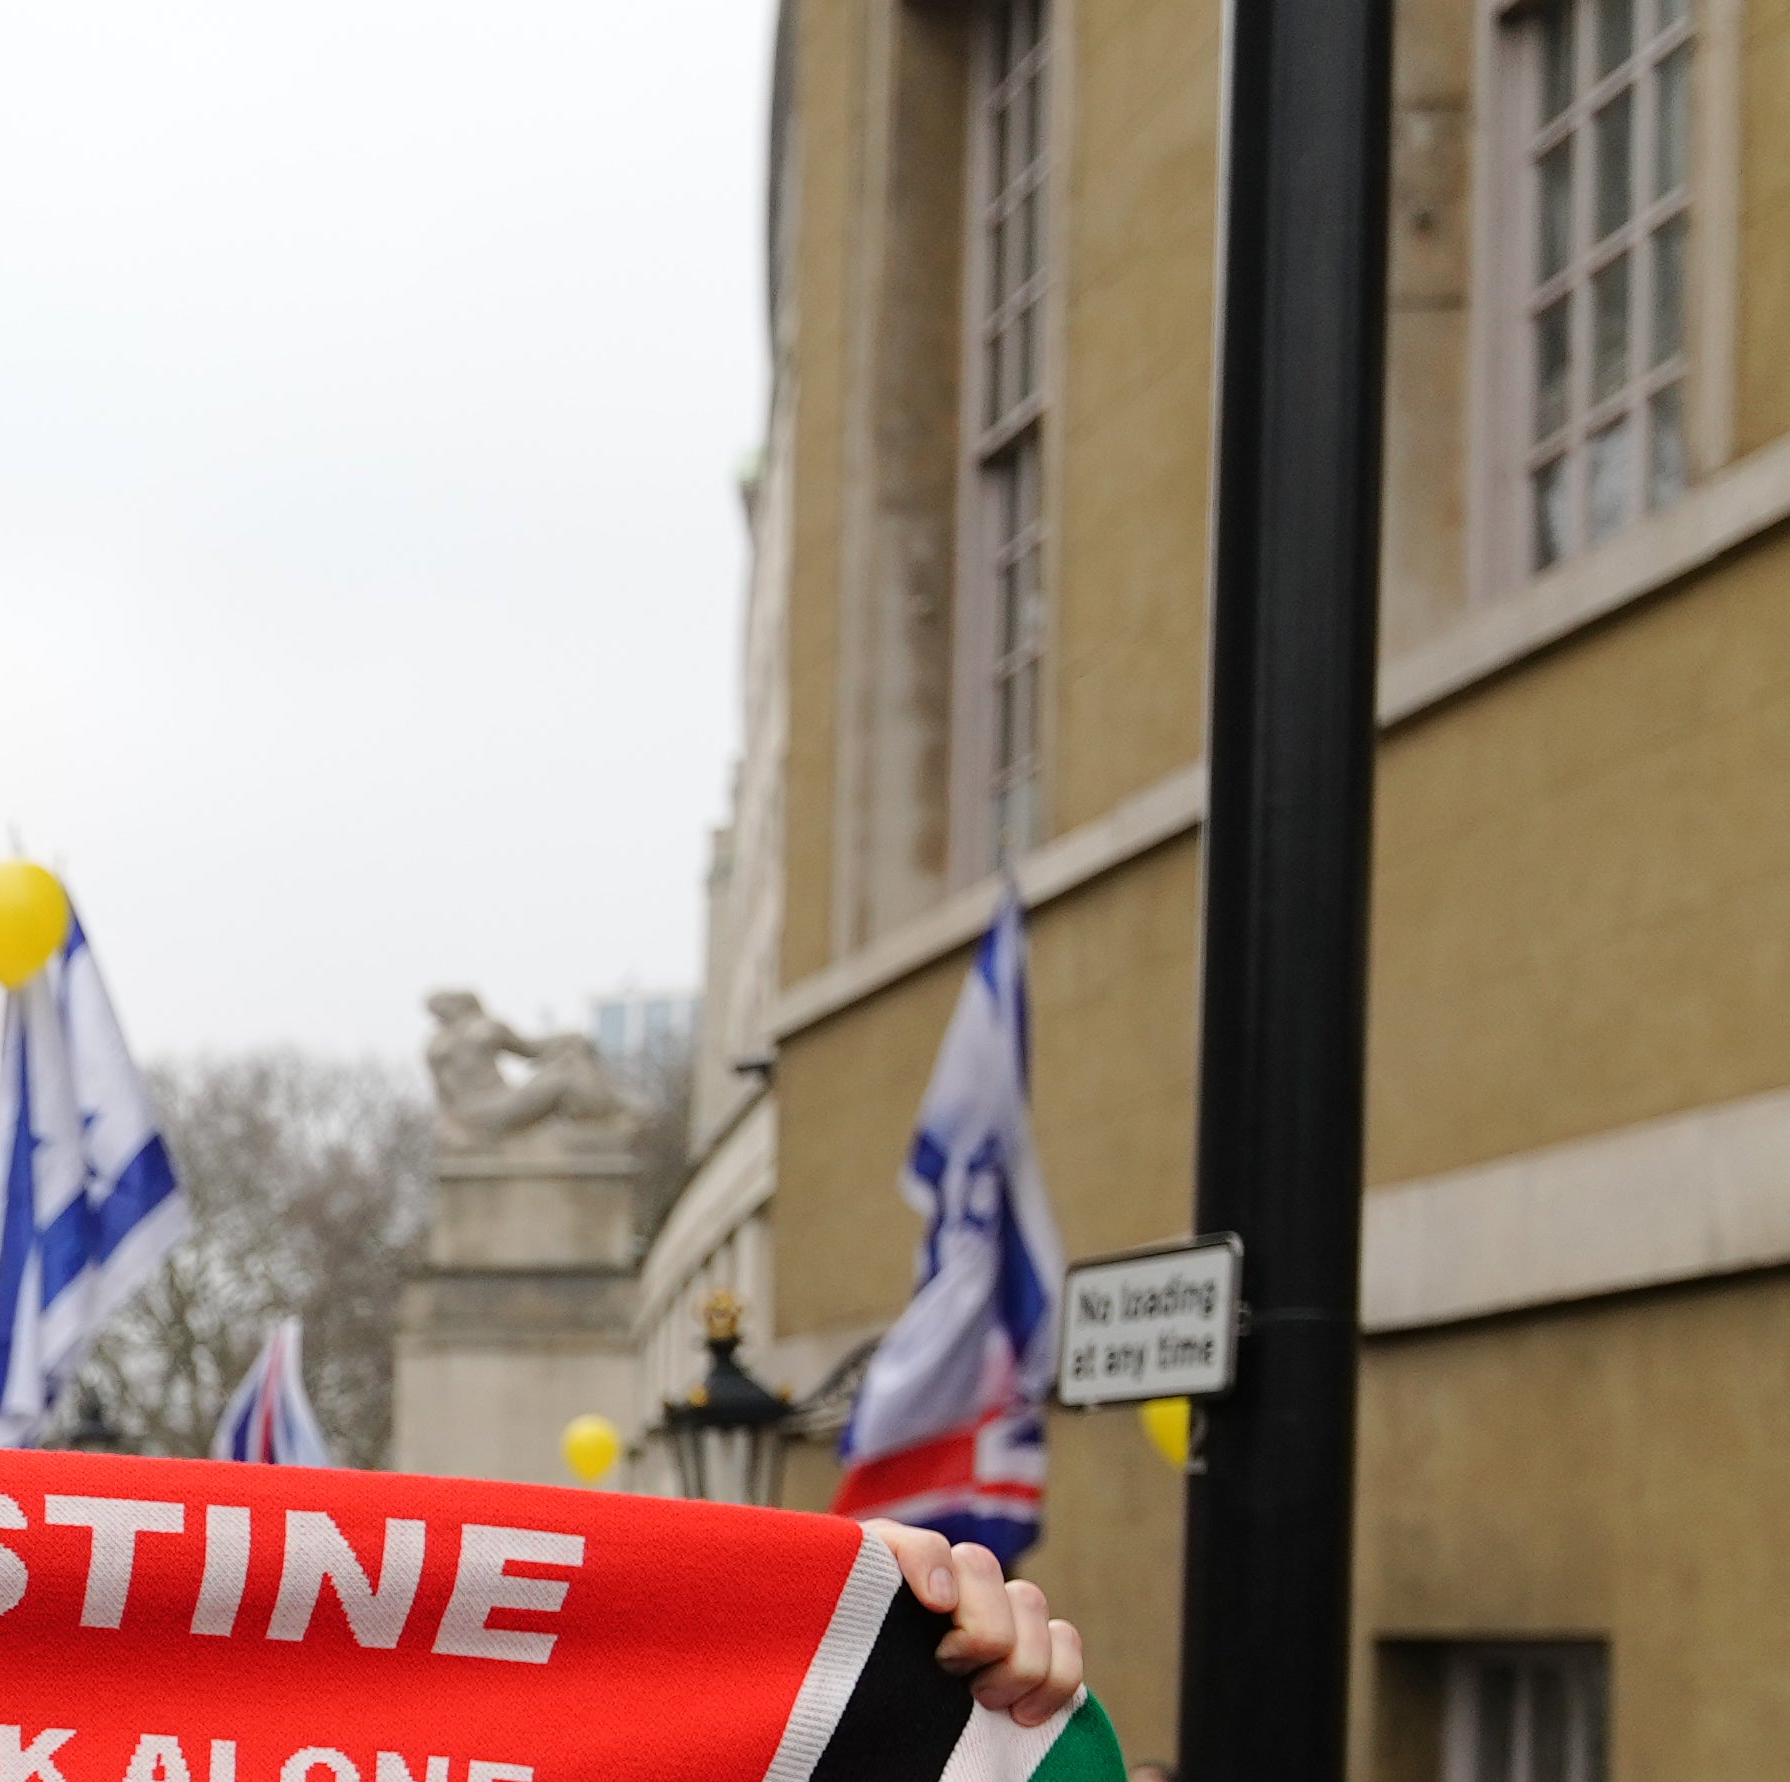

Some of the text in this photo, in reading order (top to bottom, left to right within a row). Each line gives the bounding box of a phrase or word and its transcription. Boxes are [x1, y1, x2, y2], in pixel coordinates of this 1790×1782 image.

[1078, 1273, 1215, 1325] No loading
[1074, 1330, 1215, 1384] at any time
